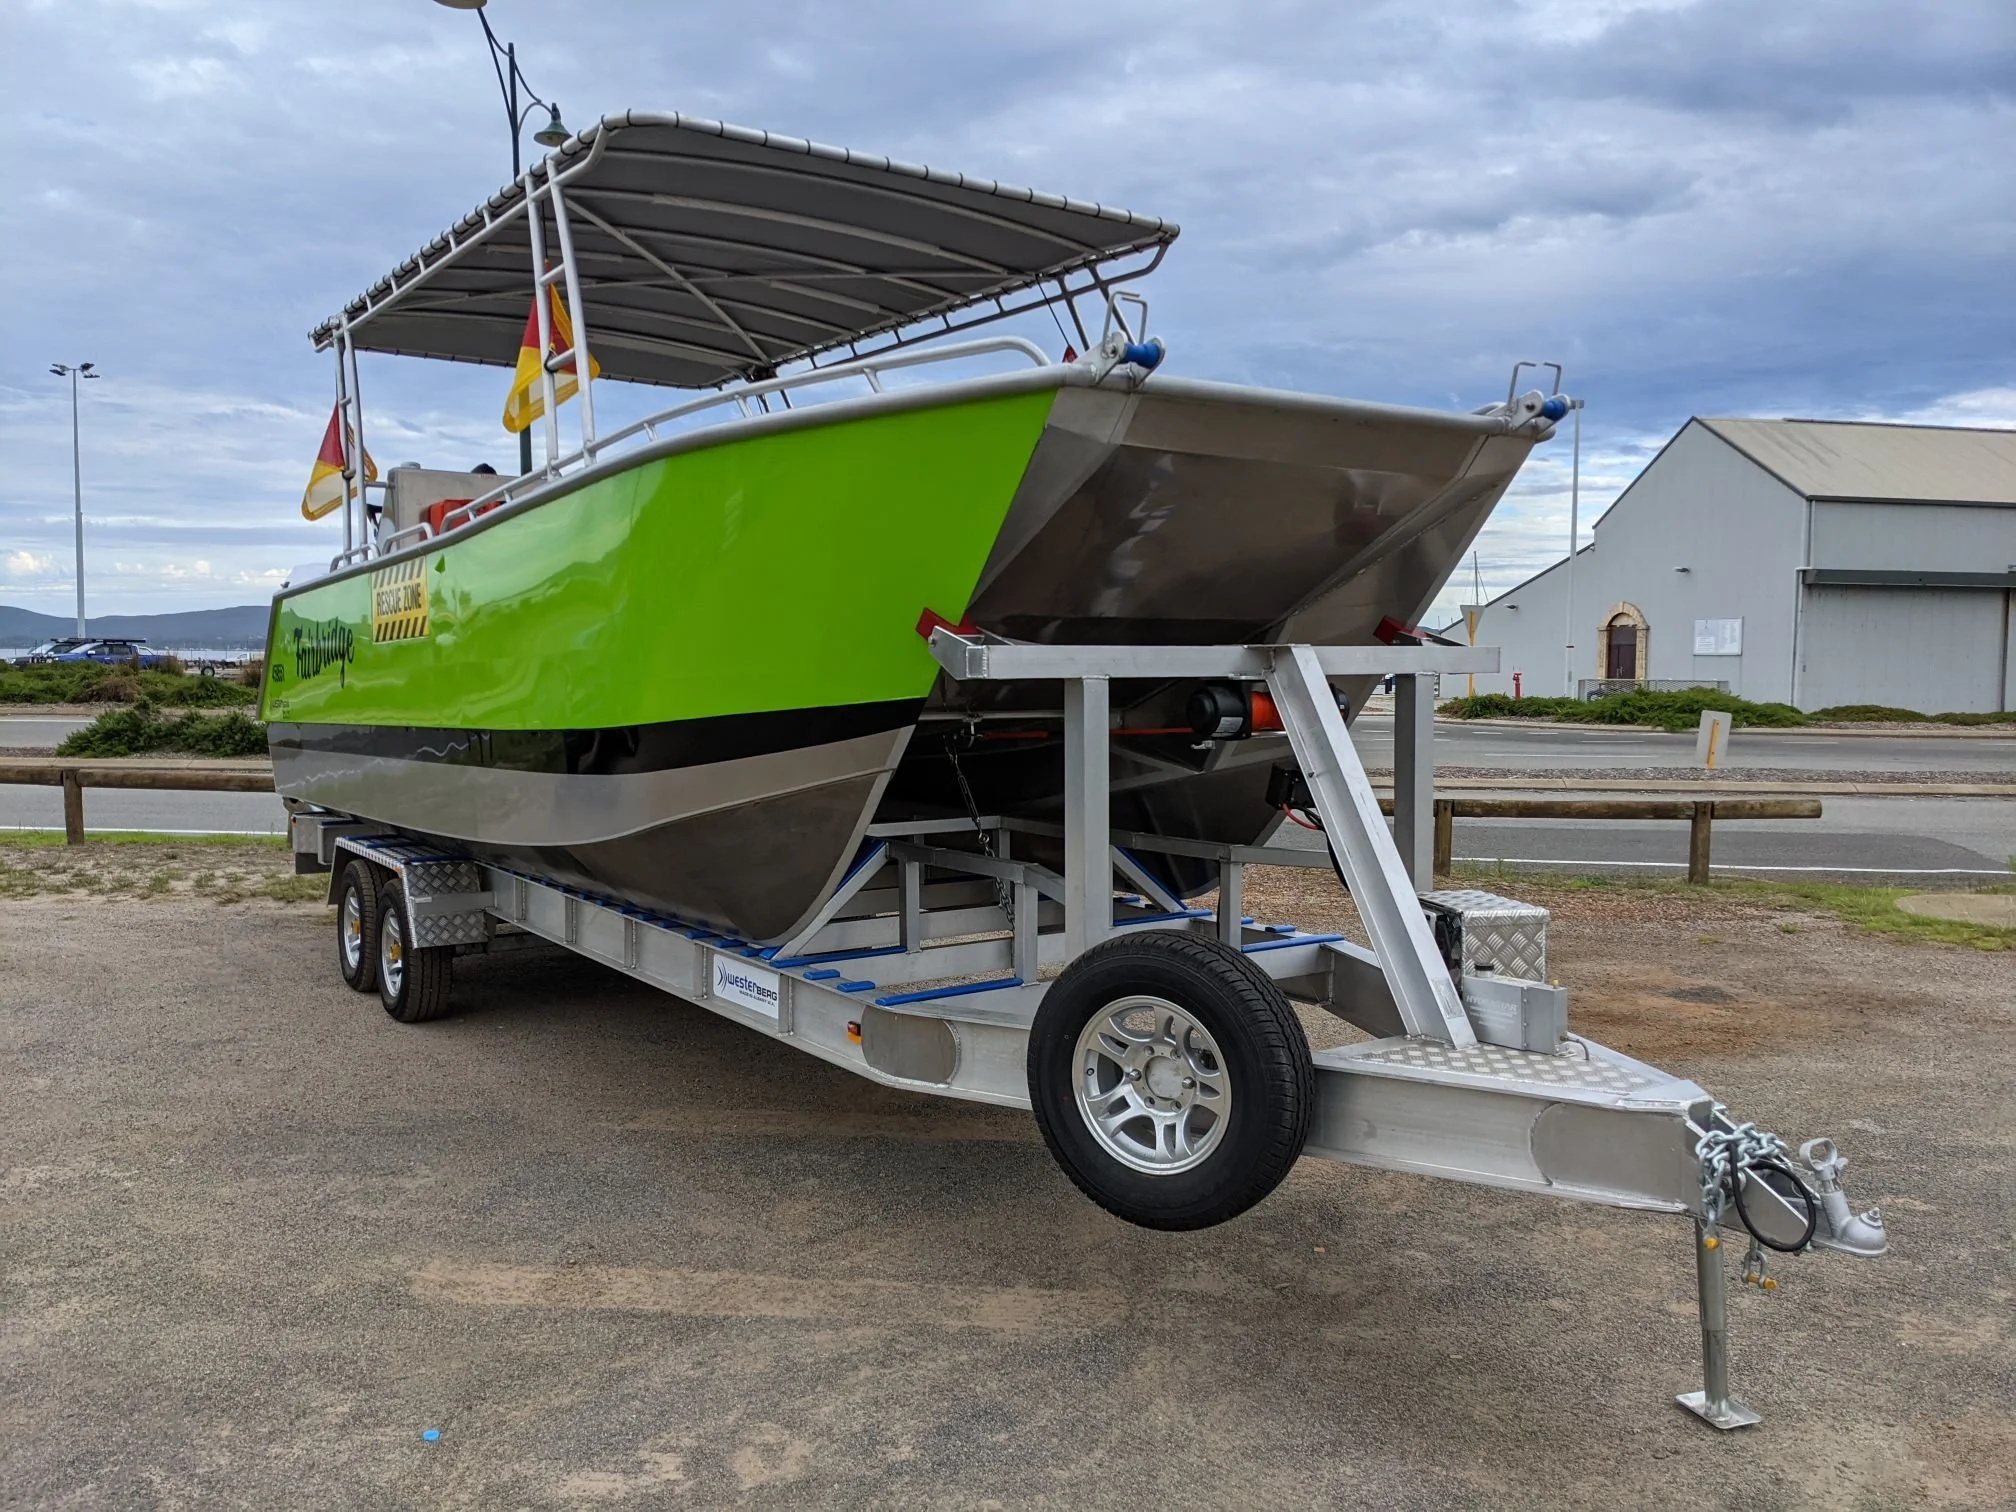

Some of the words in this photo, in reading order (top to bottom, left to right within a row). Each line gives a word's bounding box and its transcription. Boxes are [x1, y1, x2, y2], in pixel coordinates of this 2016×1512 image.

[376, 587, 402, 617] RESCUE
[403, 583, 422, 611] ZONE
[293, 616, 355, 689] Fairbridge
